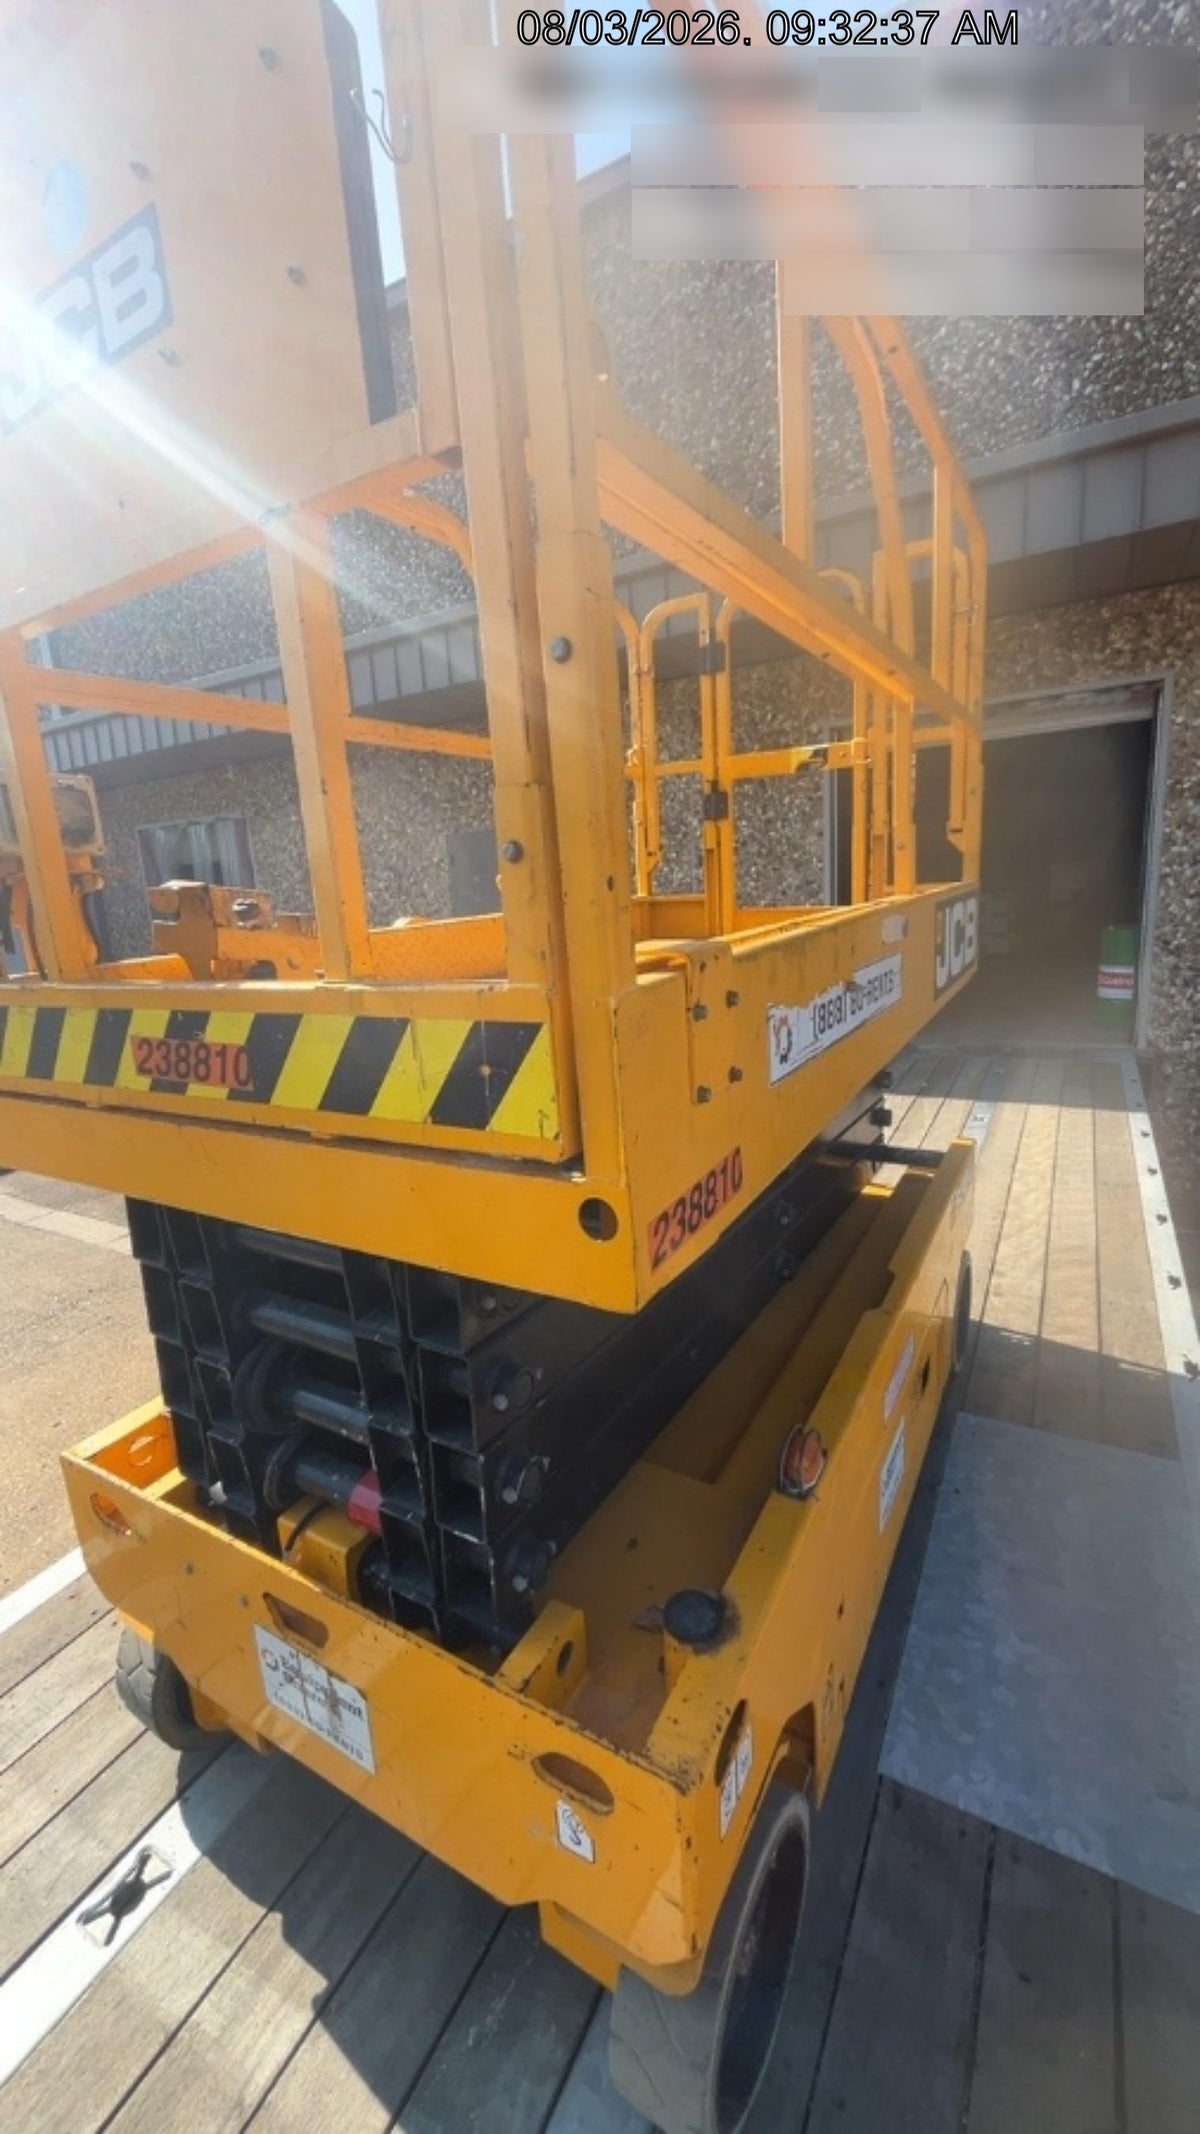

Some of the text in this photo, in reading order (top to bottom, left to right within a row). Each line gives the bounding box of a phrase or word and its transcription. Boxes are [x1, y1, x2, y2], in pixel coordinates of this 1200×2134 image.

[935, 897, 977, 990] JCB
[136, 1037, 252, 1088] 238810
[651, 1144, 743, 1272] 238810
